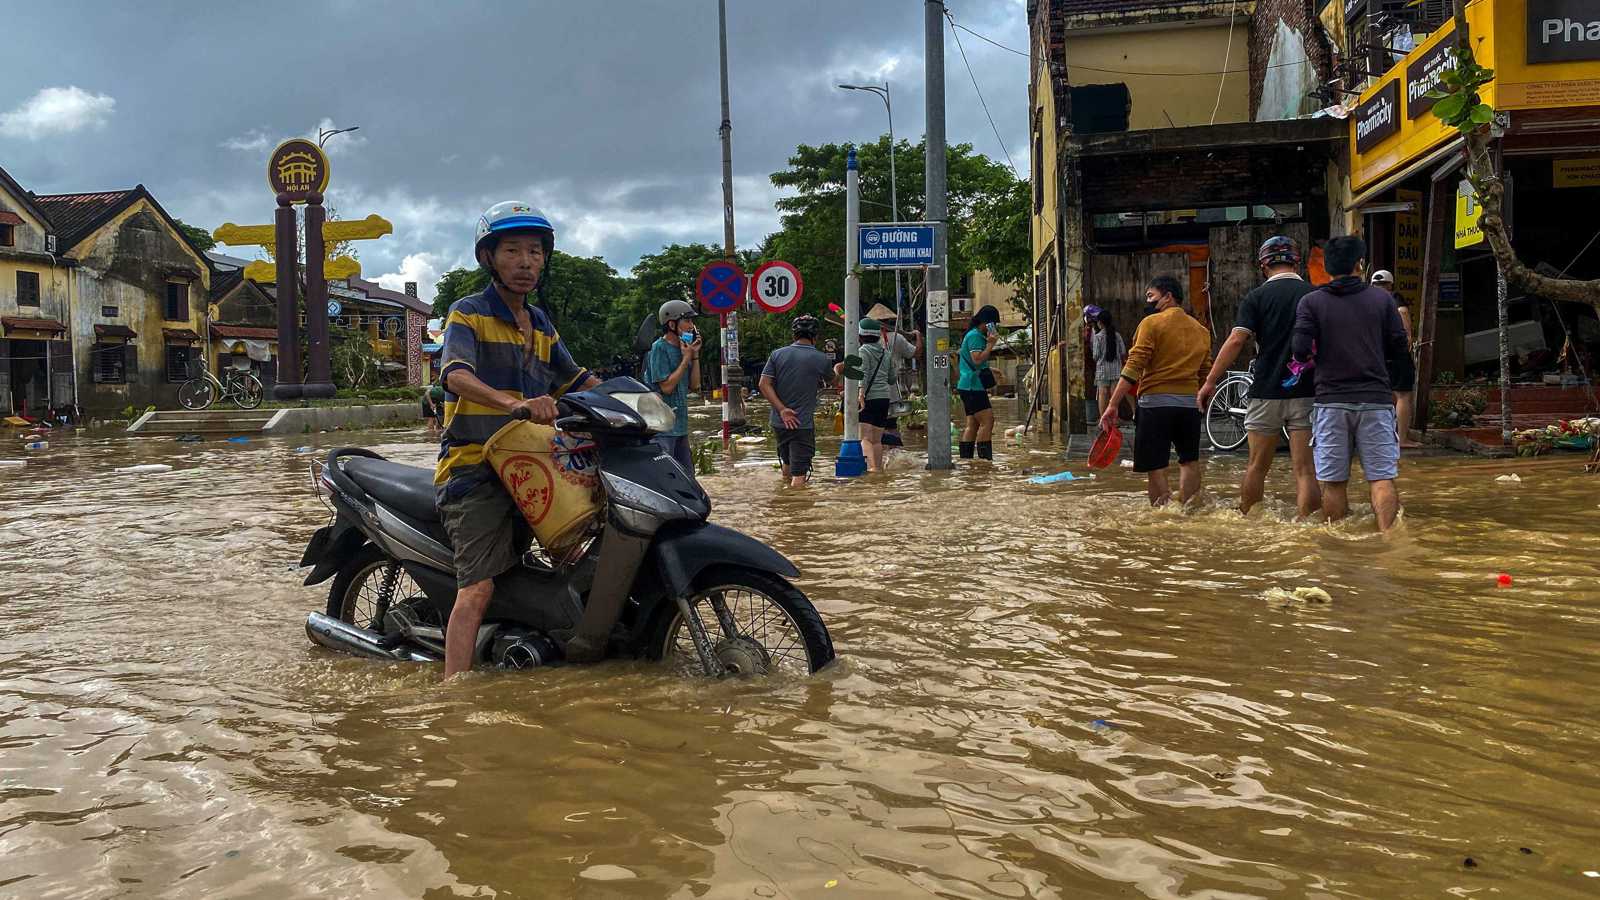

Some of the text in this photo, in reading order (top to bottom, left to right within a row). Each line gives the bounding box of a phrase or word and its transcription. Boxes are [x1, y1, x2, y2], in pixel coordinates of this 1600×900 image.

[1357, 102, 1392, 140] Pharmacity
[286, 184, 310, 192] HỘI AN
[881, 229, 918, 243] ĐƯỜNG
[888, 247, 899, 260] THỊ
[900, 247, 916, 258] MINH
[916, 247, 932, 258] KHAI
[765, 276, 789, 297] 30
